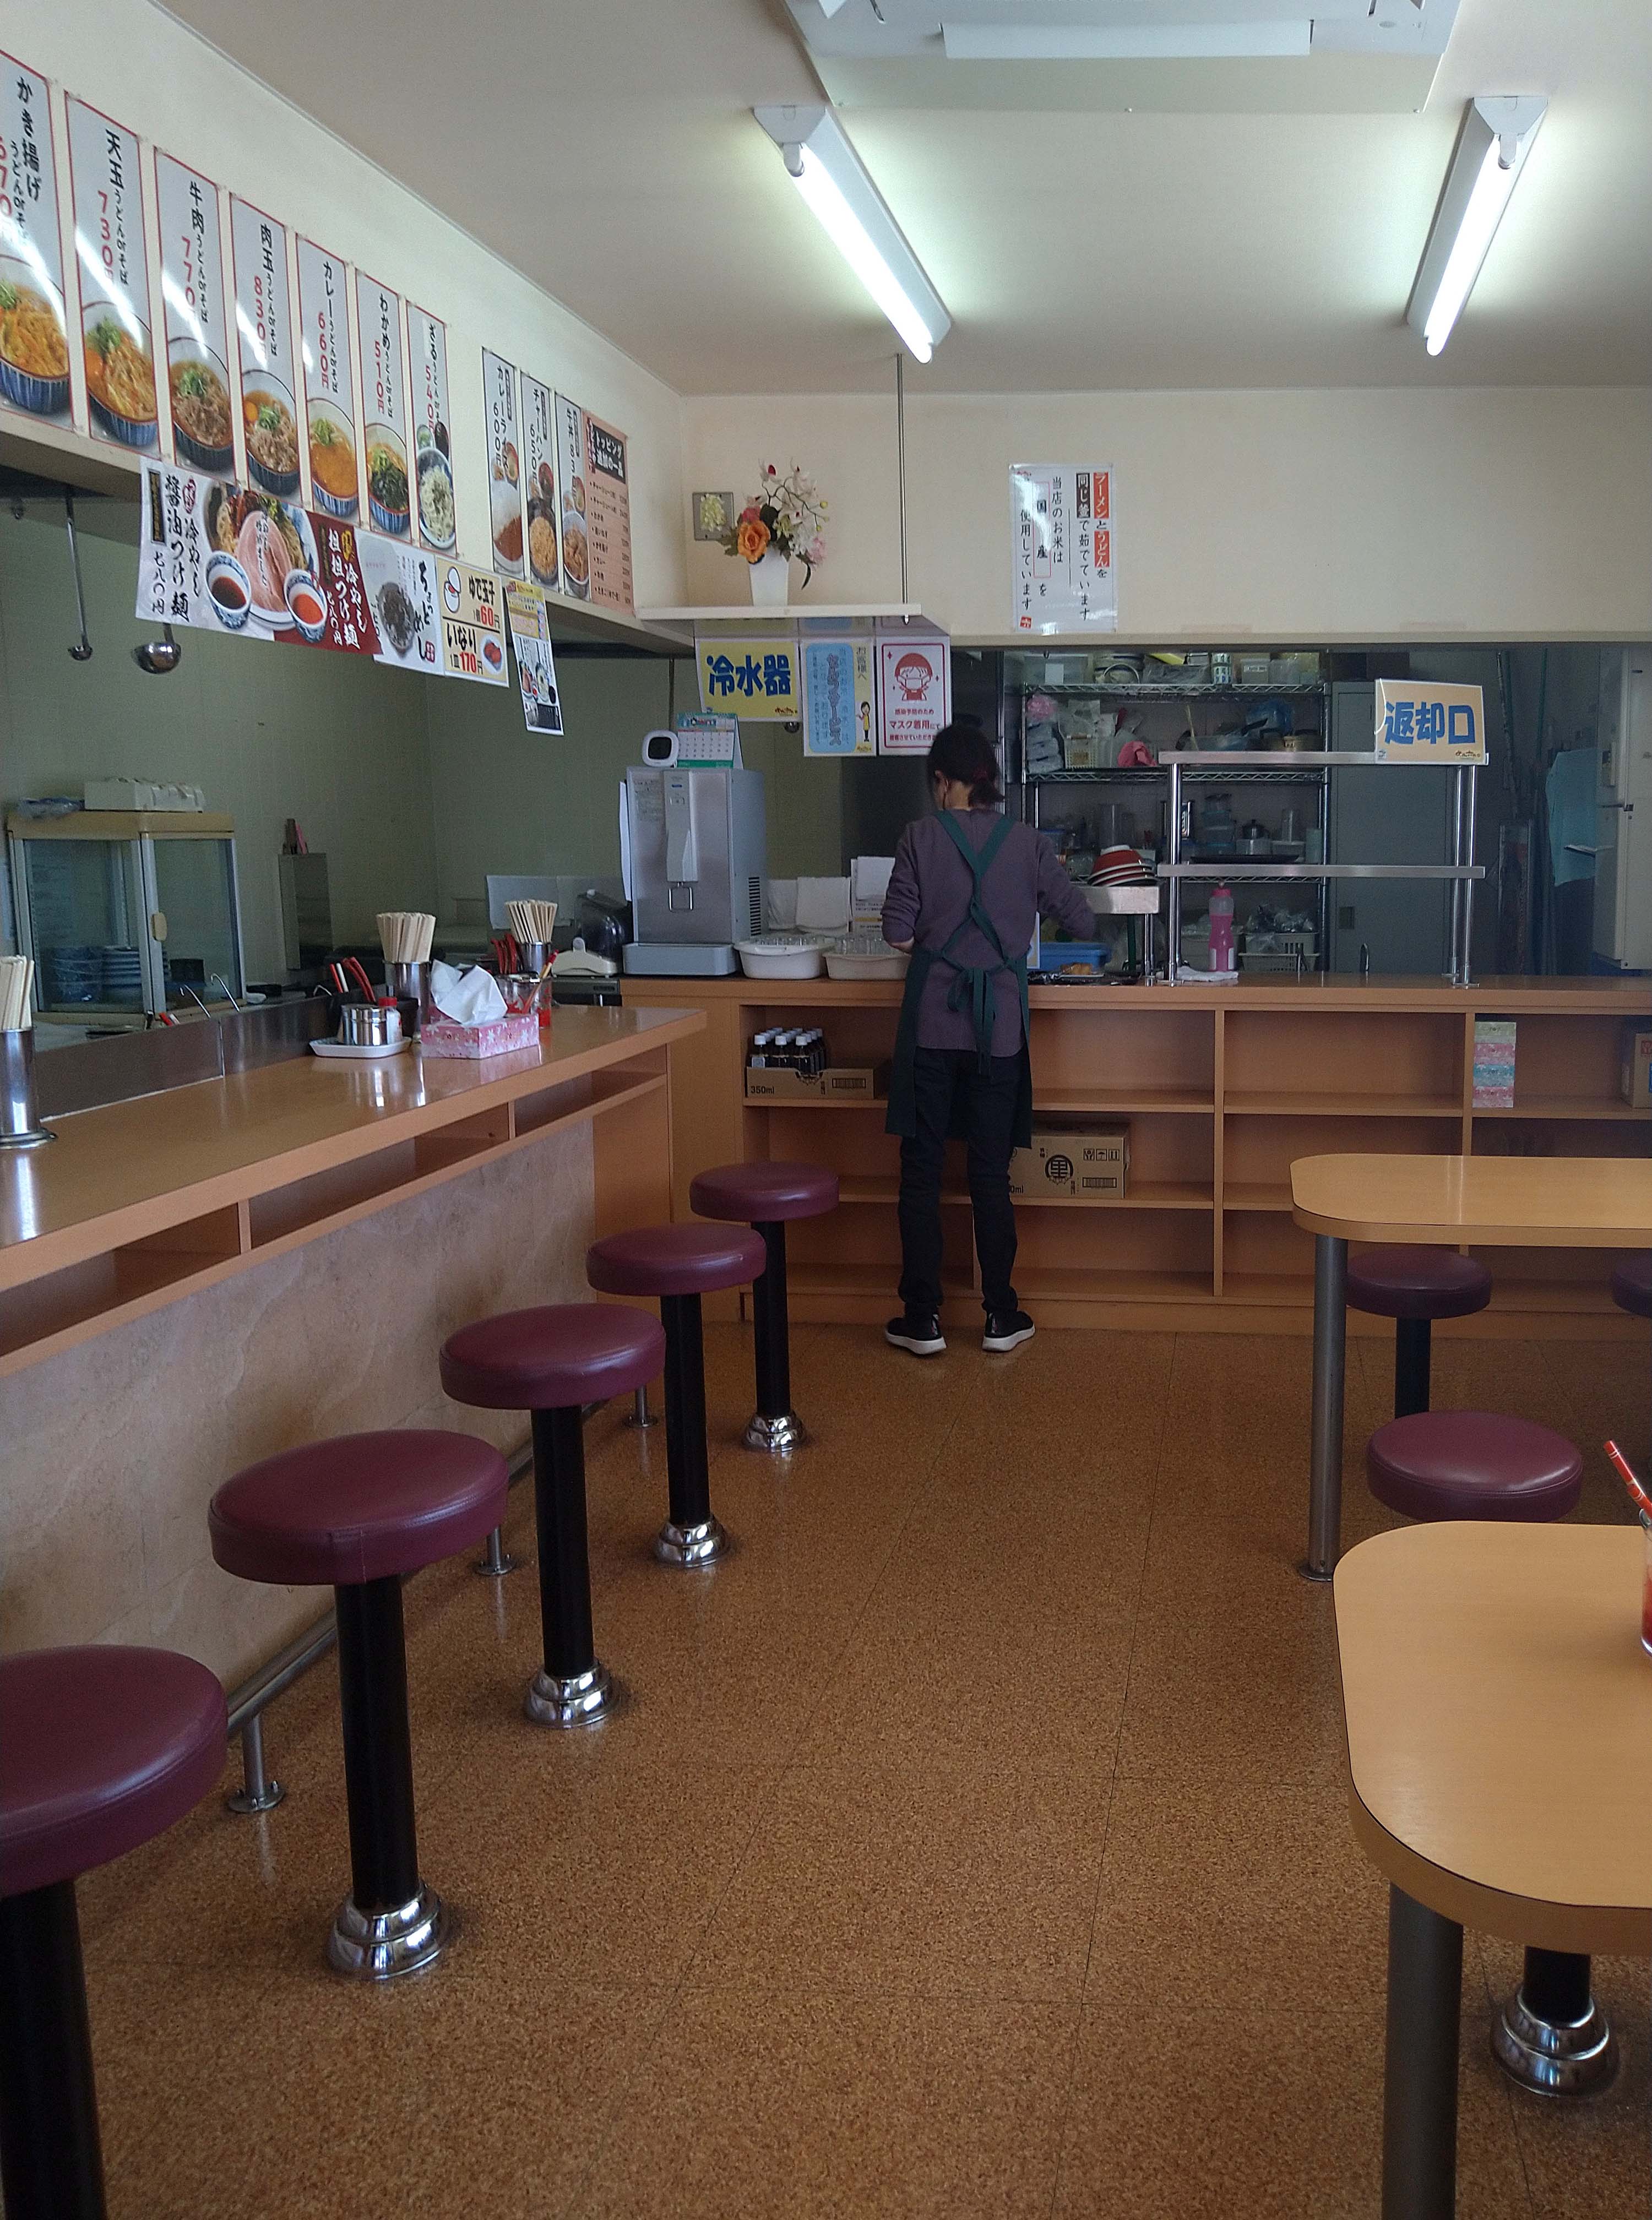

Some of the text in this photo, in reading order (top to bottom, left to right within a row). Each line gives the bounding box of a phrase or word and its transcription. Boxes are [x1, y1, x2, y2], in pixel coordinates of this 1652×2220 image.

[16, 76, 42, 202] かき揚げ
[181, 236, 195, 307] 770
[318, 311, 329, 389] 660円
[375, 340, 384, 414] 510円
[493, 402, 502, 465] 600円
[497, 365, 509, 469] カレーライス
[533, 388, 543, 461] チャーハン
[596, 431, 622, 459] トッピング
[165, 474, 190, 623] 醤油つけ麺
[1052, 476, 1064, 564] 当店のお米は
[1077, 474, 1090, 621] 同じ釜で茹でています
[1094, 473, 1109, 578] ラーメンとうどんを
[184, 517, 200, 598] 冷やし
[469, 575, 496, 606] ゆで玉子
[1020, 509, 1032, 611] 使用しています
[344, 562, 368, 634] 冷やし
[447, 622, 477, 654] いなり
[707, 654, 791, 697] 冷水器
[827, 653, 841, 746] セルフサービス
[889, 720, 940, 730] マスク着用にて
[1385, 701, 1476, 744] 返却口
[751, 1086, 774, 1095] 350ml
